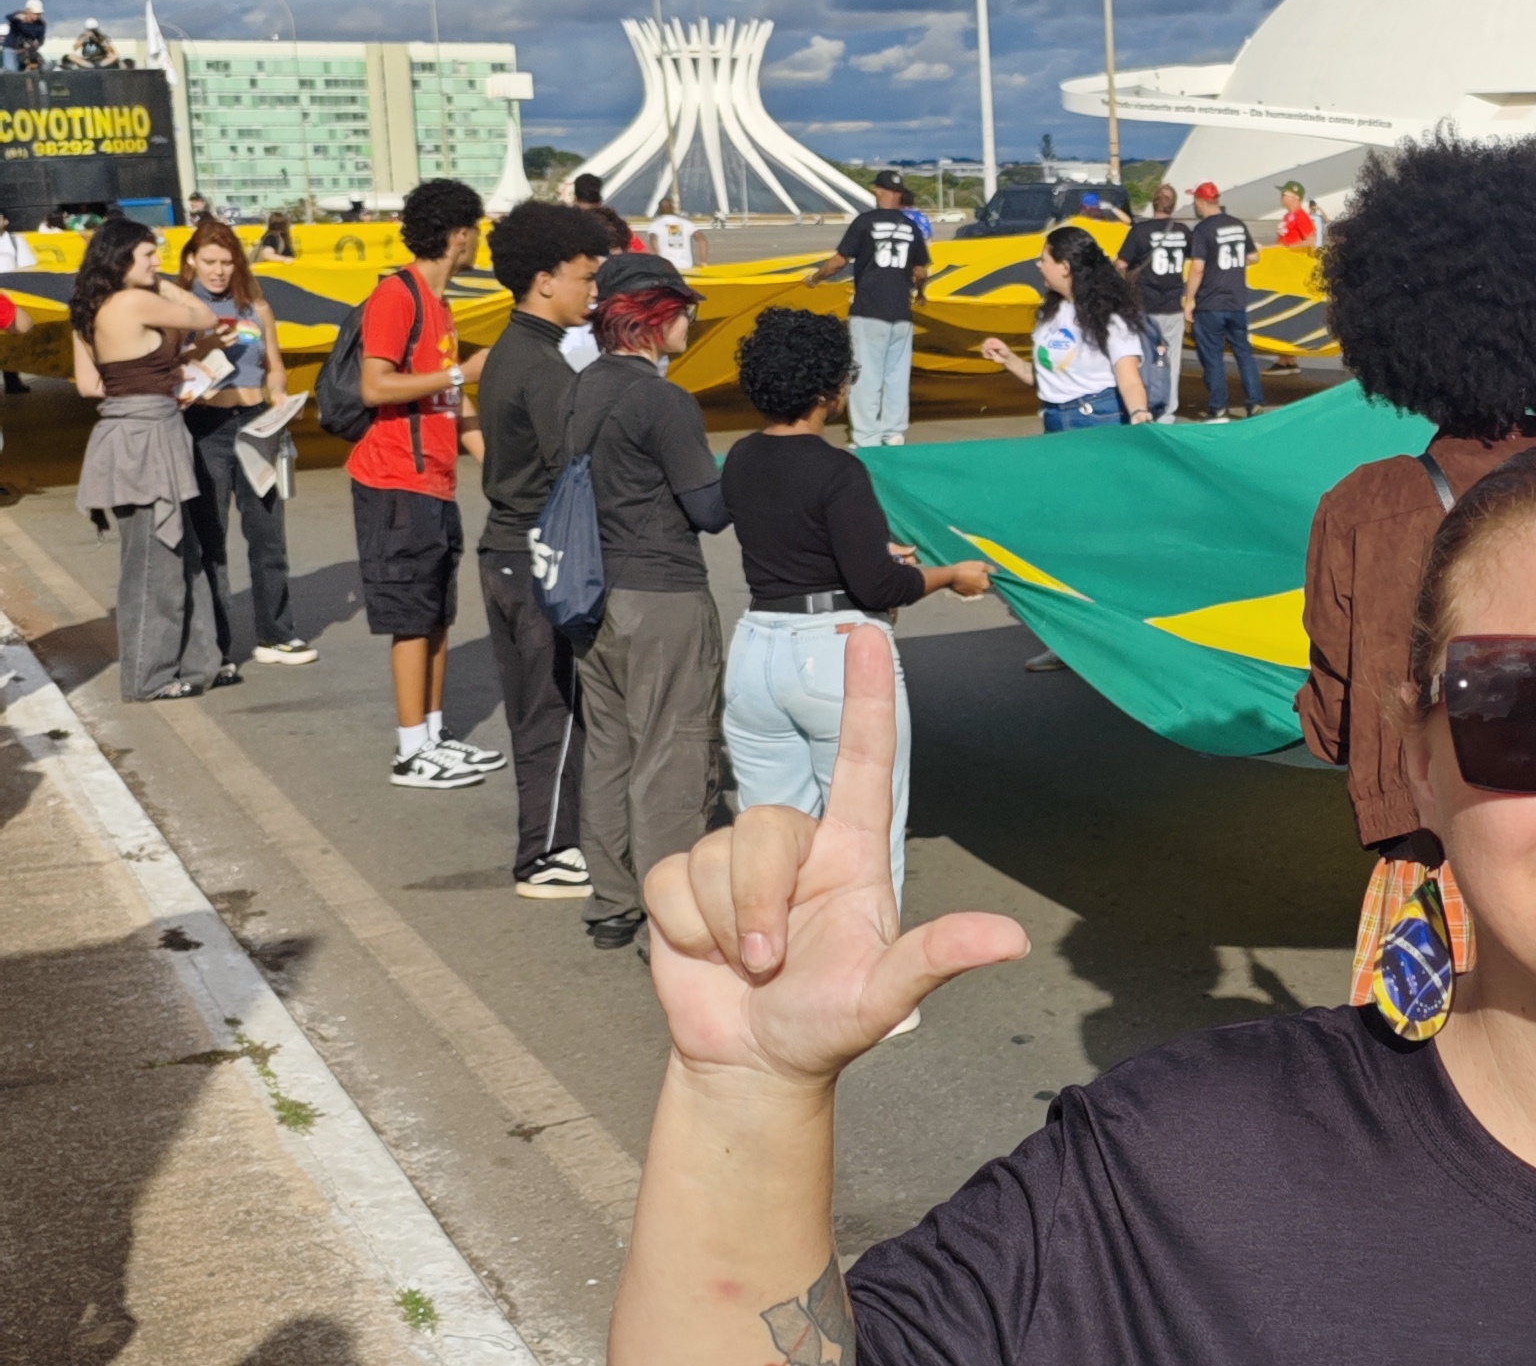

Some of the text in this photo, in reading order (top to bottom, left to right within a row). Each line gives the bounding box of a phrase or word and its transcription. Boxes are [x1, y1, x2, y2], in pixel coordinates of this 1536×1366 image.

[0, 104, 151, 143] COYOTINHO
[1265, 110, 1326, 123] humanidade
[1328, 115, 1355, 125] como
[1357, 118, 1393, 128] prática
